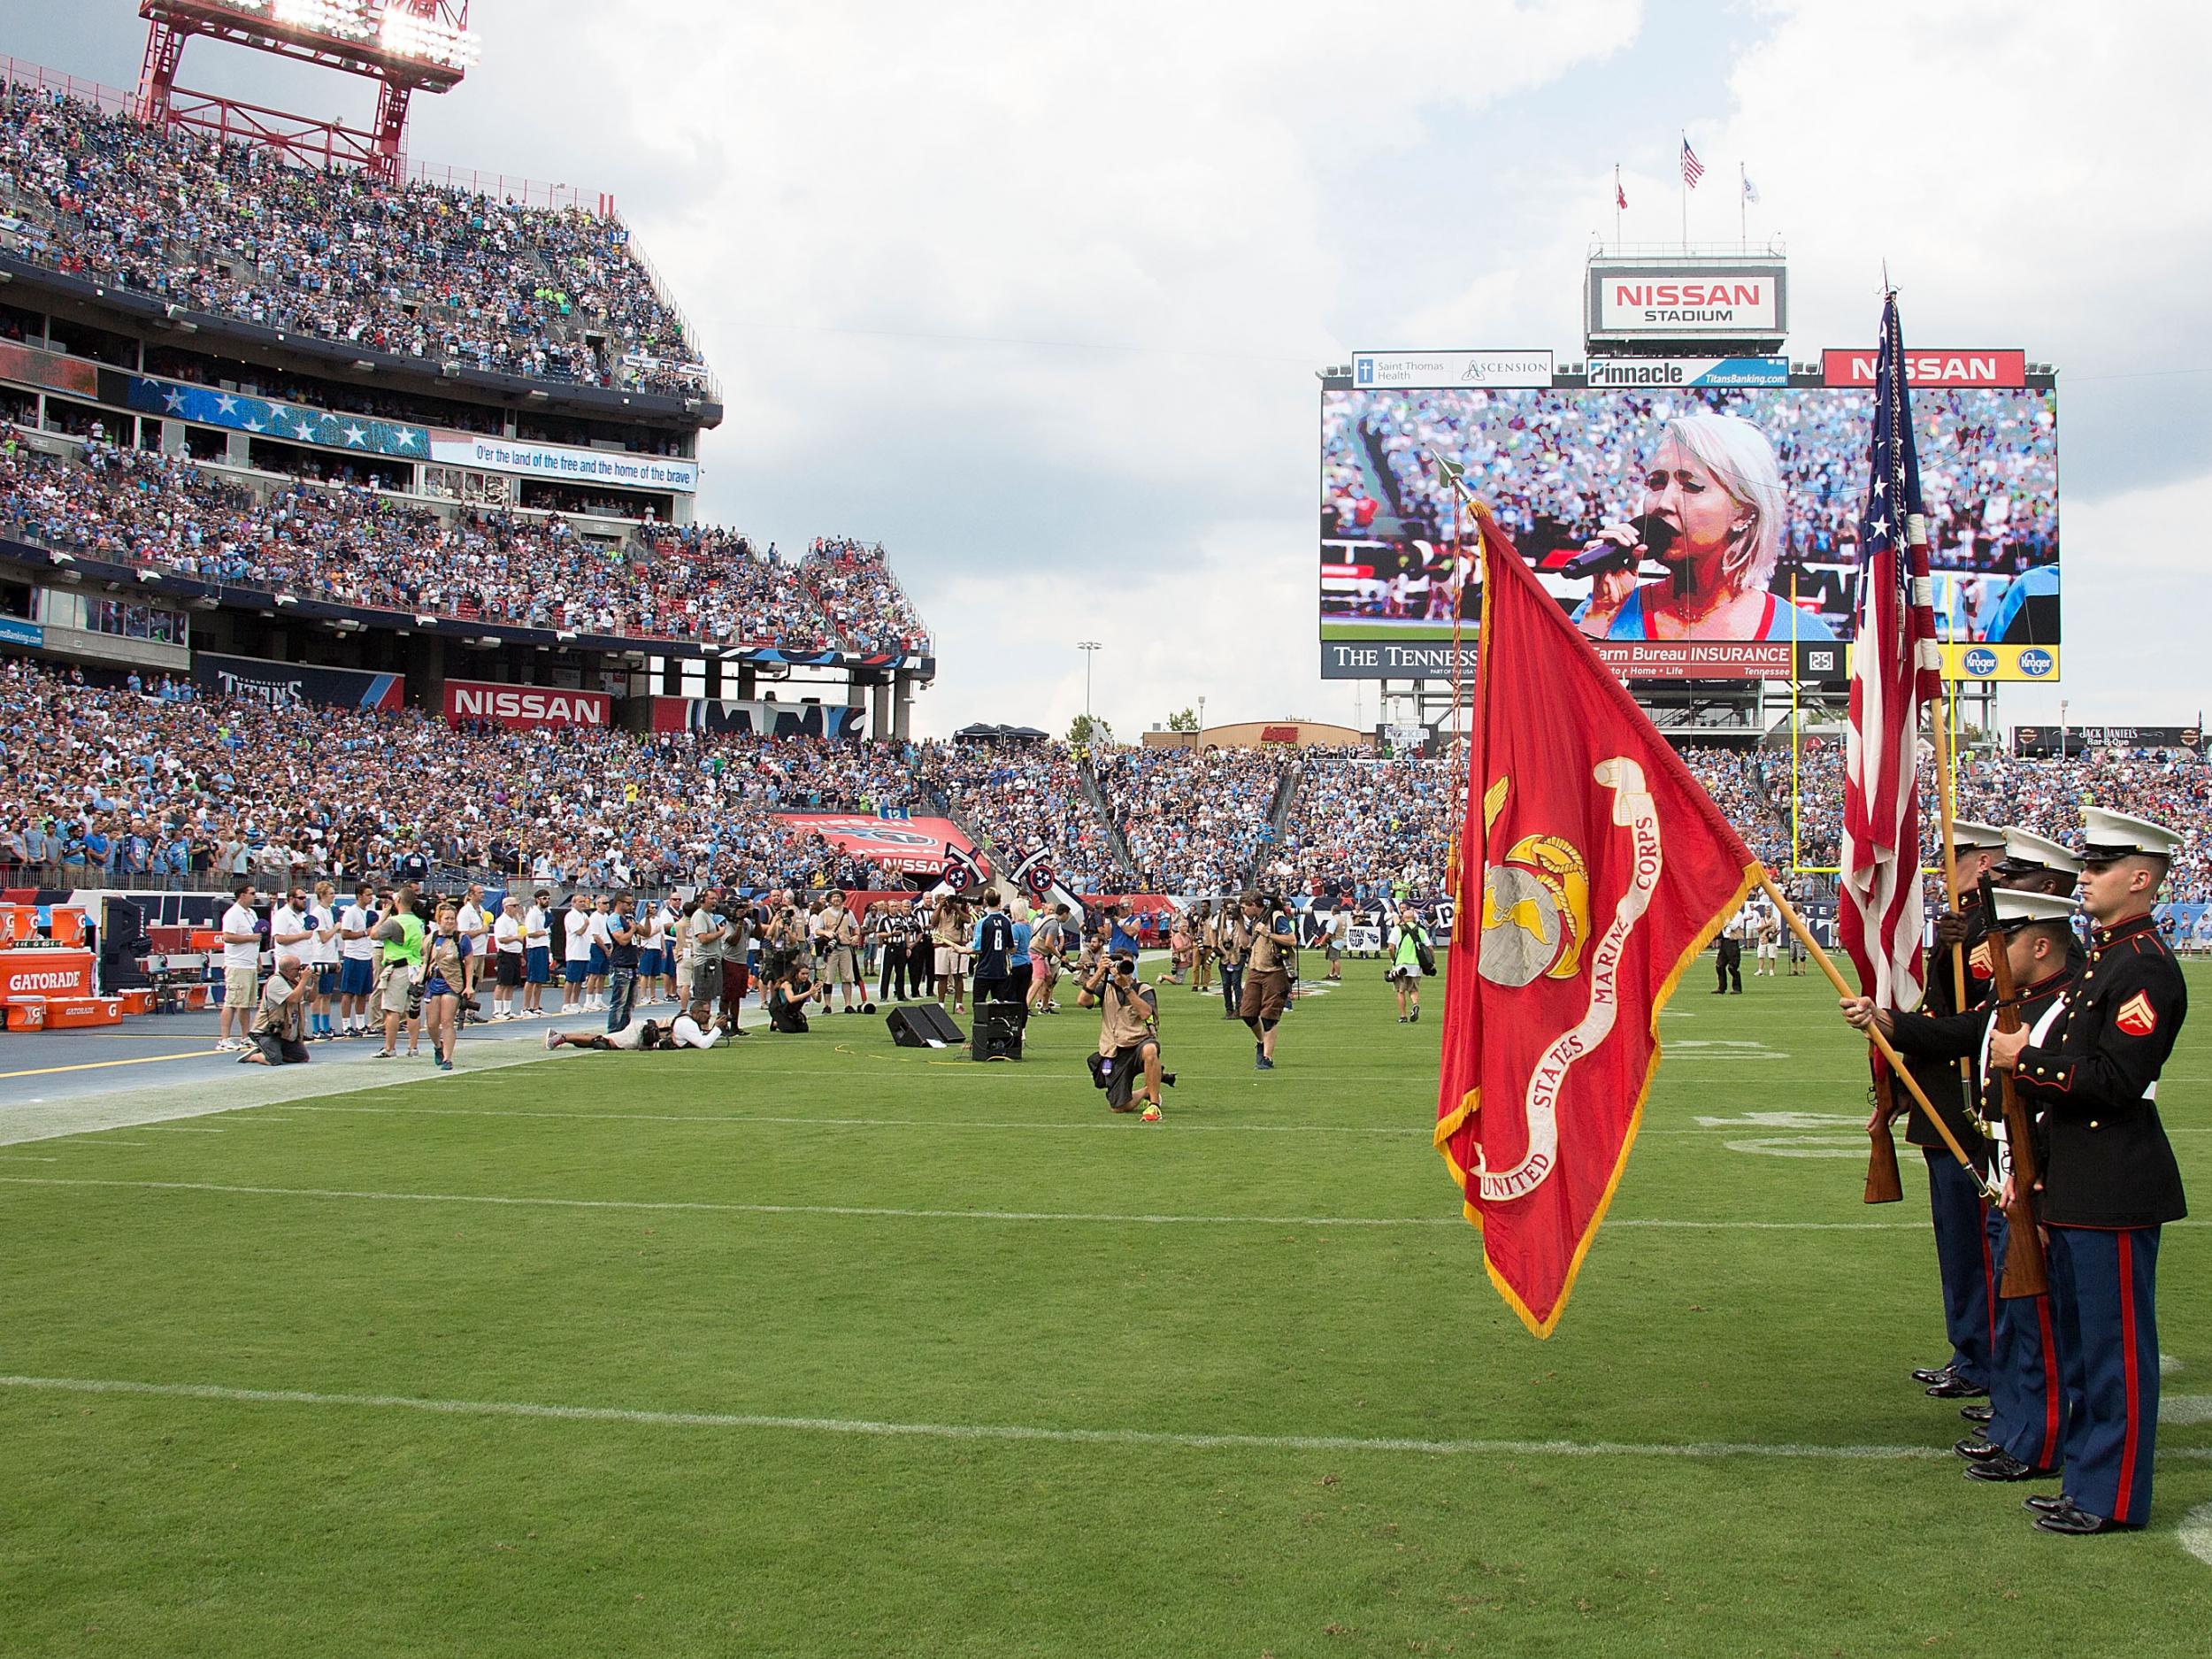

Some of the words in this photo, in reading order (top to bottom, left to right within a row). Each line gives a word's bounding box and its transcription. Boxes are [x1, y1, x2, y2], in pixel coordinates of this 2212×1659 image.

[1617, 285, 1760, 305] NISSAN
[1644, 311, 1732, 322] STADIUM
[1378, 361, 1404, 372] Saint
[1405, 361, 1444, 372] Thomas
[1467, 361, 1548, 377] ASCENSION
[1589, 362, 1683, 384] Pinnacle
[1852, 357, 1996, 380] NSAN
[1378, 371, 1411, 380] Health
[1705, 373, 1786, 386] TitansBanking.com
[477, 446, 494, 461] O'er
[495, 449, 511, 462] the
[511, 451, 531, 467] land
[533, 454, 542, 467] of
[543, 454, 558, 470] the
[559, 456, 578, 472] free
[580, 457, 596, 473] and
[597, 459, 612, 475] the
[614, 460, 638, 479] home
[641, 463, 650, 480] of
[651, 465, 664, 481] the
[666, 466, 690, 484] brave
[1333, 646, 1379, 666] THE
[1632, 647, 1686, 662] Bureau
[1690, 647, 1790, 662] INSURANCE
[1812, 652, 1831, 669] 25
[1966, 652, 1997, 673] Kroger
[2021, 653, 2051, 673] Kroger
[1630, 666, 1656, 675] Home
[1666, 666, 1684, 675] Life
[1744, 667, 1790, 676] Tennessee
[218, 670, 303, 706] TITANS
[240, 678, 286, 687] TENNESSEE
[455, 688, 602, 724] NISSAN
[2078, 726, 2101, 739] JACK
[2103, 726, 2139, 739] DANIEL'S
[2086, 738, 2130, 747] Bar-B-Que
[887, 809, 901, 819] 12
[794, 819, 916, 828] NISSAN
[994, 930, 1002, 950] 8
[1348, 929, 1364, 938] TITAN
[10, 971, 81, 991] GATORADE
[33, 1008, 41, 1018] G
[65, 1006, 96, 1016] GATORADE
[108, 1003, 117, 1017] G
[1482, 1153, 1549, 1196] UNITED
[1532, 1034, 1584, 1108] STATES
[1594, 915, 1630, 1005] MARINE
[1635, 816, 1658, 891] CORPS
